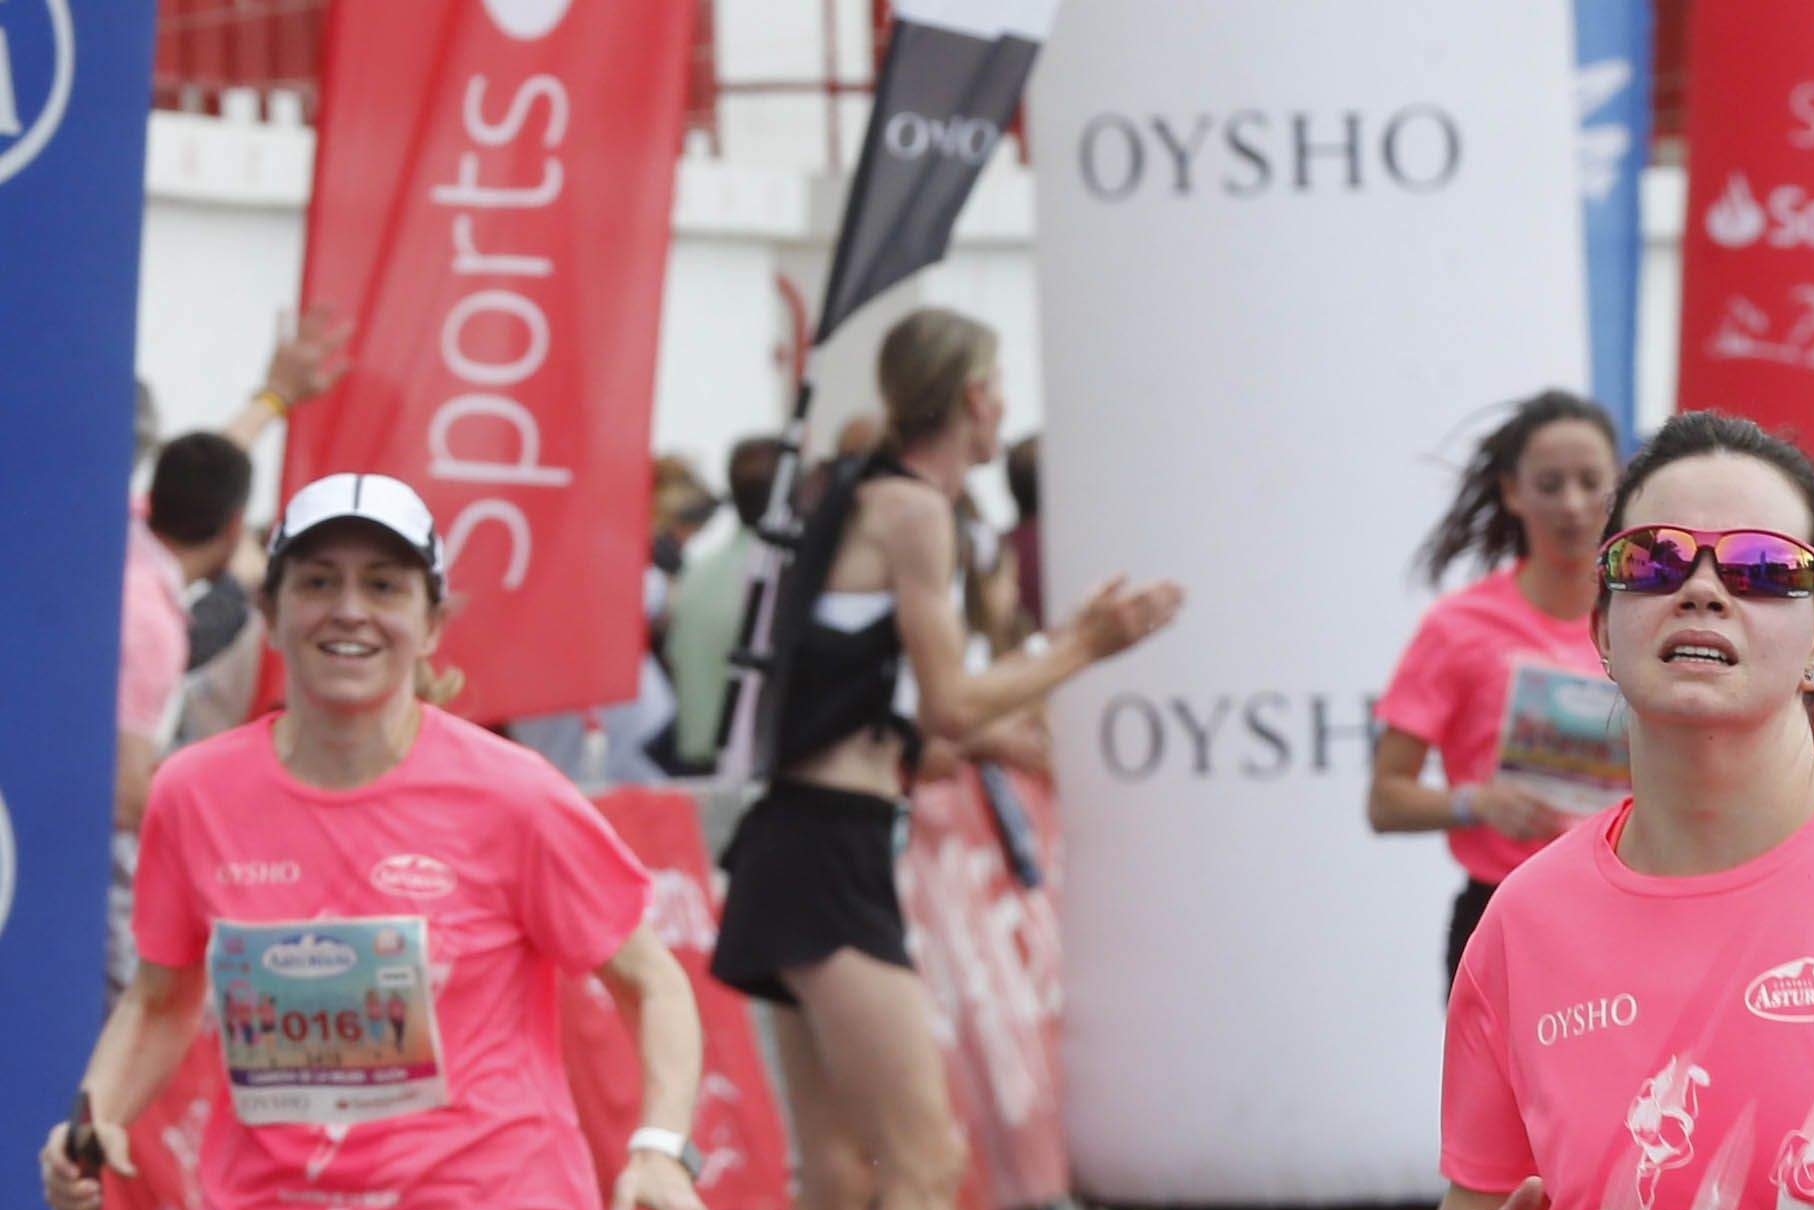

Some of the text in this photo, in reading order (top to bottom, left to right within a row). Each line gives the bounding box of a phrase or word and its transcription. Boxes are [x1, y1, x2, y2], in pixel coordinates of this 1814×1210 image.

[1078, 103, 1464, 200] OYSHO
[1097, 690, 1376, 782] OYSH
[281, 1008, 364, 1044] 016
[1536, 992, 1638, 1046] OYSHO
